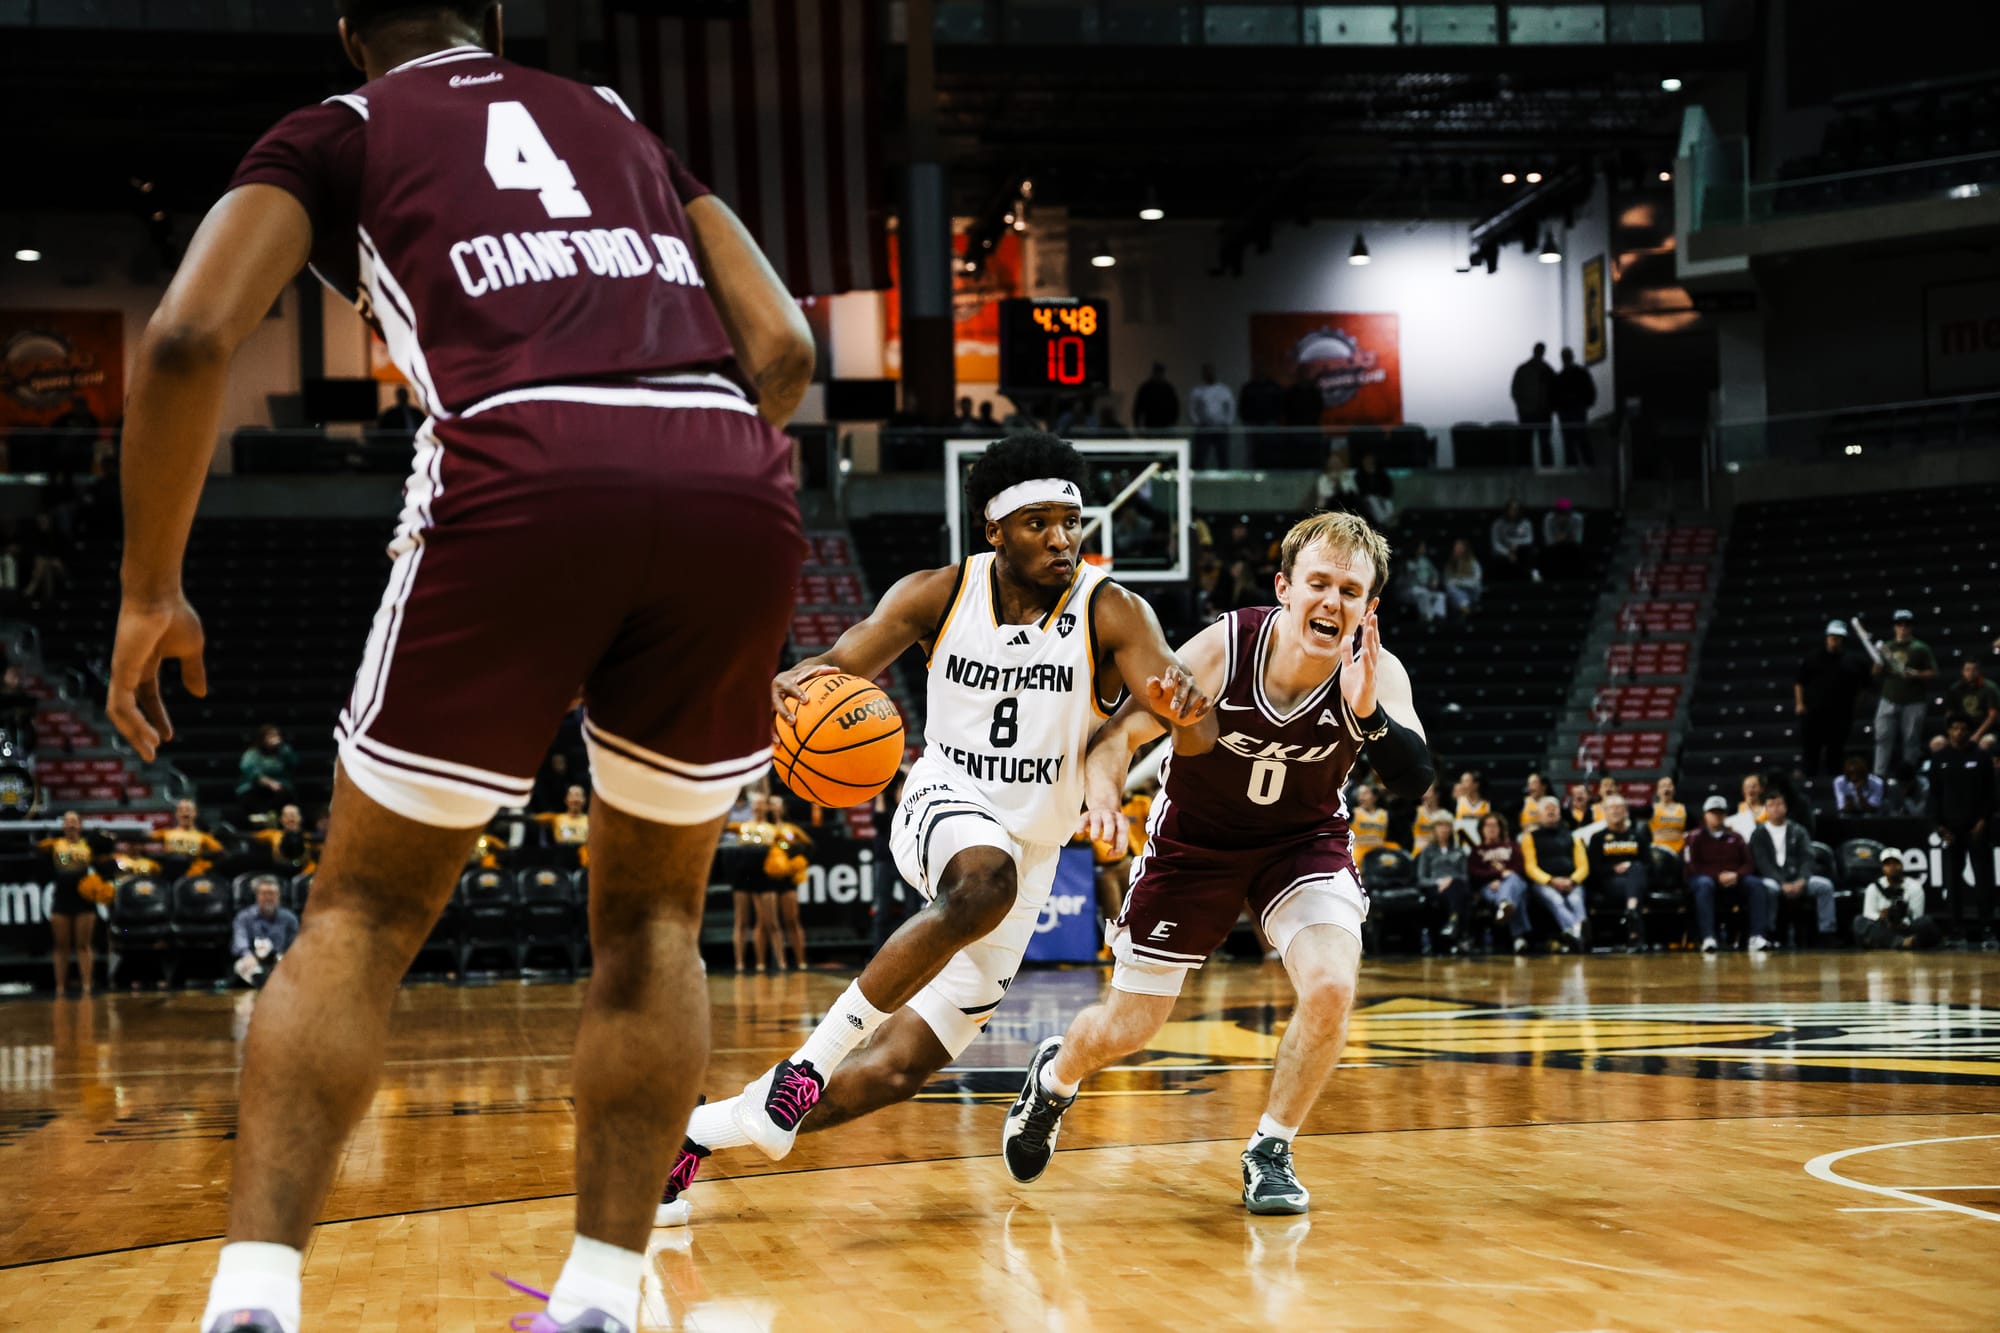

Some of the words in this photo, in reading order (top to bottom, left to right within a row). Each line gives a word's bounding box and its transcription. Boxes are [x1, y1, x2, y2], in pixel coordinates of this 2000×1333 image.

[484, 101, 592, 219] 4
[449, 227, 653, 298] CRANFORD
[1033, 305, 1097, 336] 4:48
[1046, 336, 1086, 385] 10
[945, 654, 1074, 693] NORTHERN
[989, 697, 1018, 749] 8
[1217, 731, 1340, 763] EKU
[1246, 760, 1288, 806] 0
[1148, 920, 1178, 940] E
